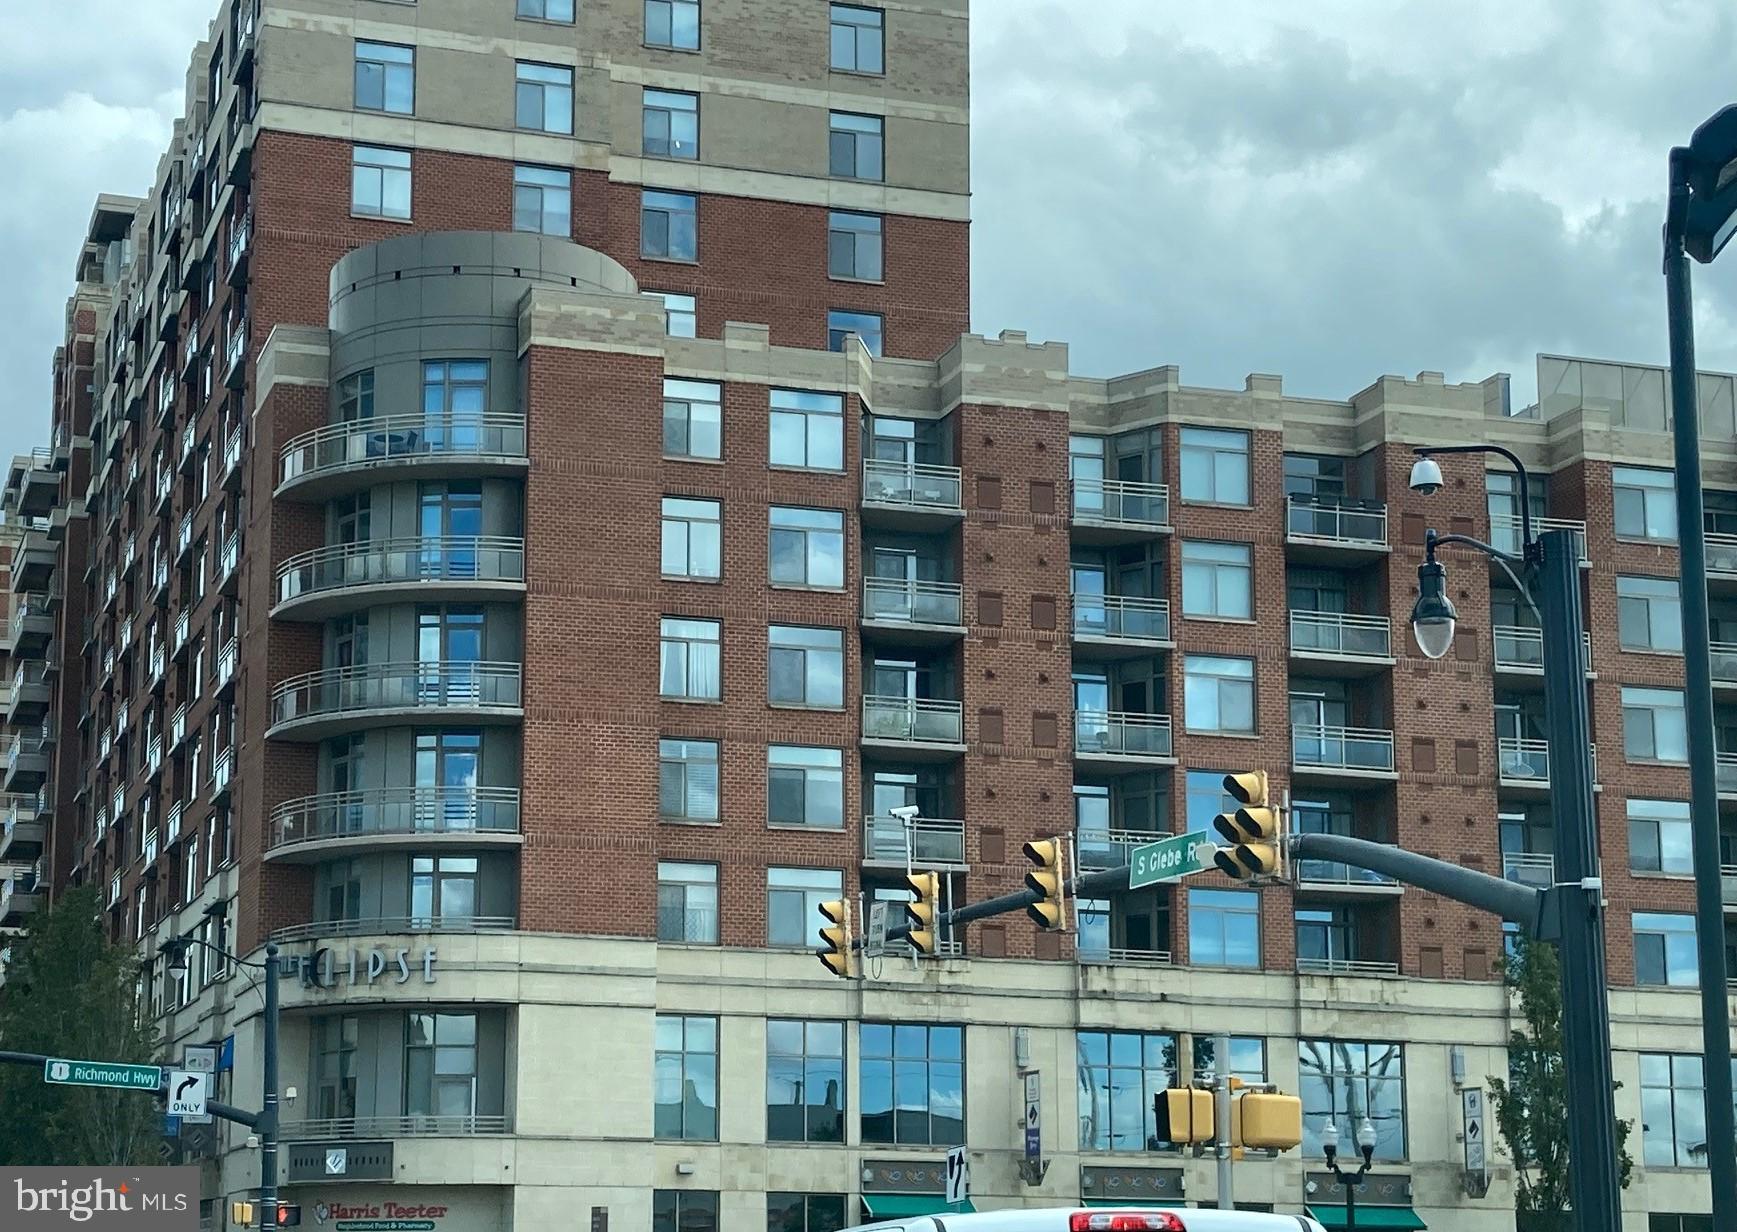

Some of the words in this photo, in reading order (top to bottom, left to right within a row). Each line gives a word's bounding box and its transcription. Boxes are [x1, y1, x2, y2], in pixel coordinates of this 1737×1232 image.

[1137, 855, 1146, 875] S
[1150, 848, 1182, 872] Glebe
[74, 1067, 129, 1083] Richmond
[133, 1072, 156, 1087] Hwy
[173, 1102, 201, 1113] ONLY
[328, 1202, 380, 1219] Harris
[383, 1202, 448, 1219] Teeter
